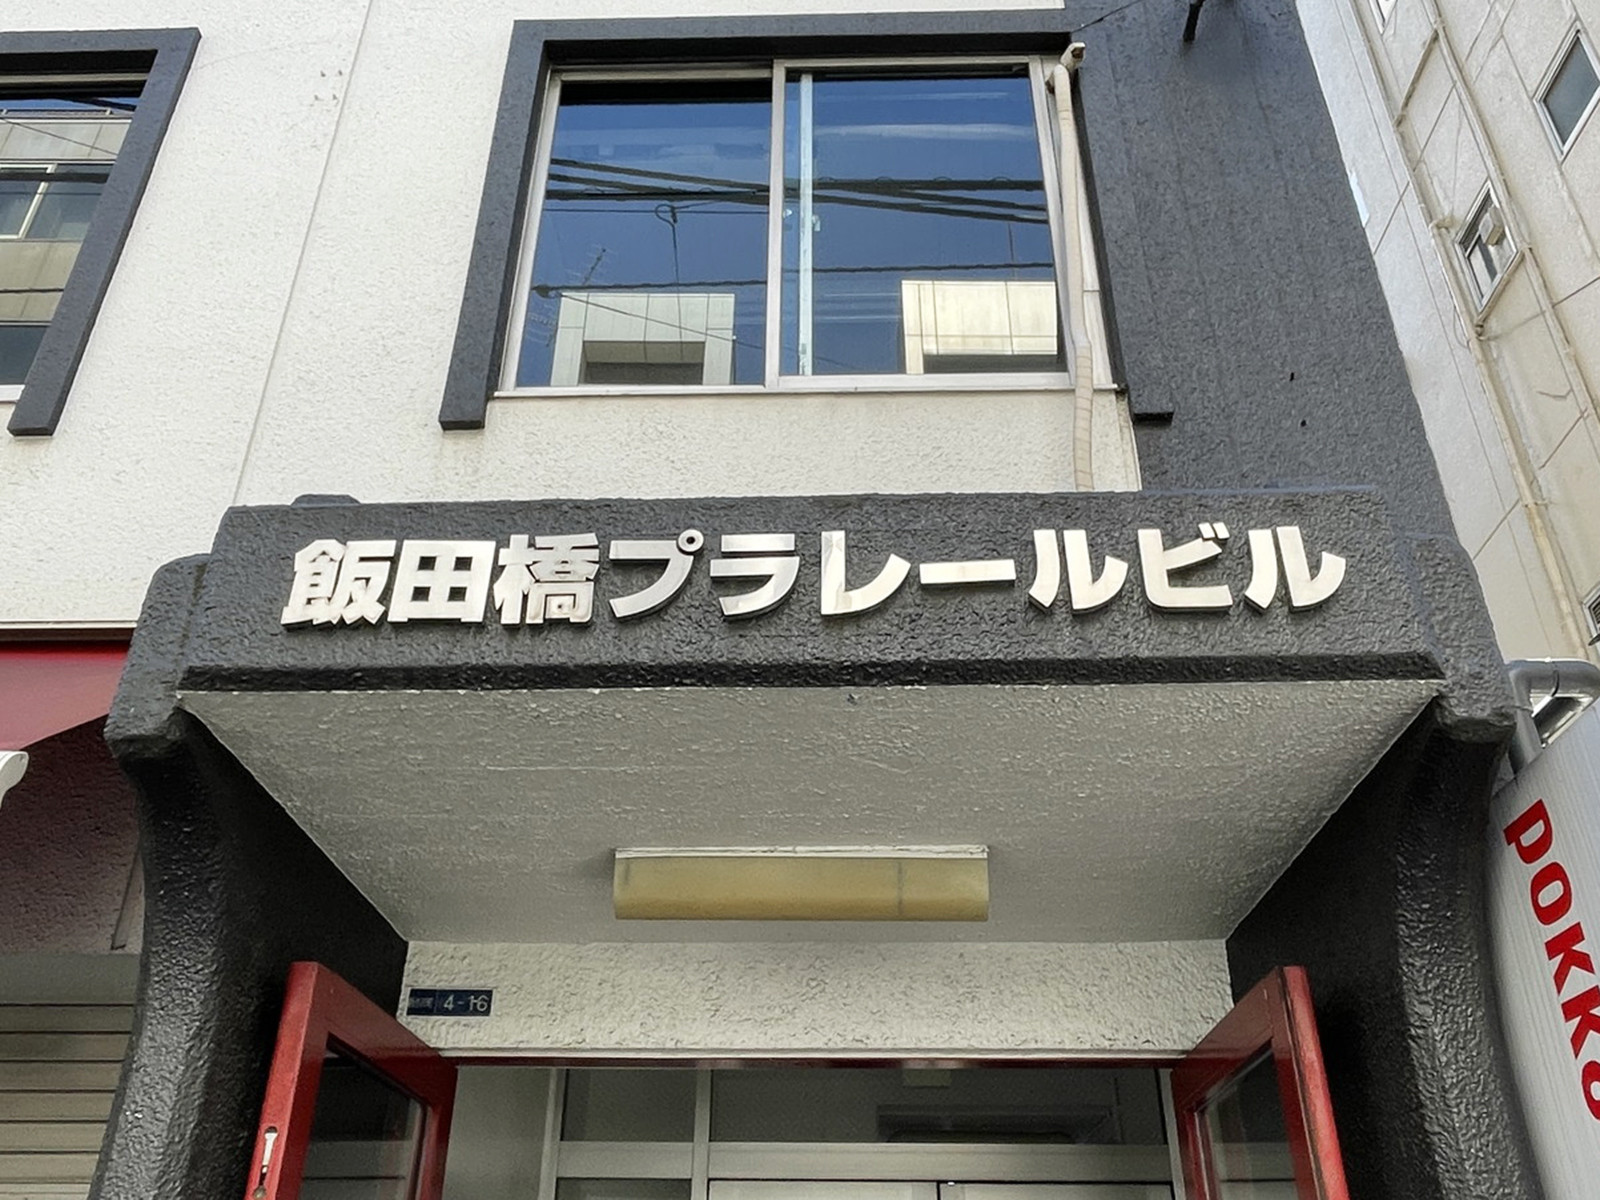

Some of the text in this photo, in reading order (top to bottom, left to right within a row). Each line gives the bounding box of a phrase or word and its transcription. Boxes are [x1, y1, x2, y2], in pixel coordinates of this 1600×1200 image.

[281, 522, 1346, 625] 飯田橋プラレールビル
